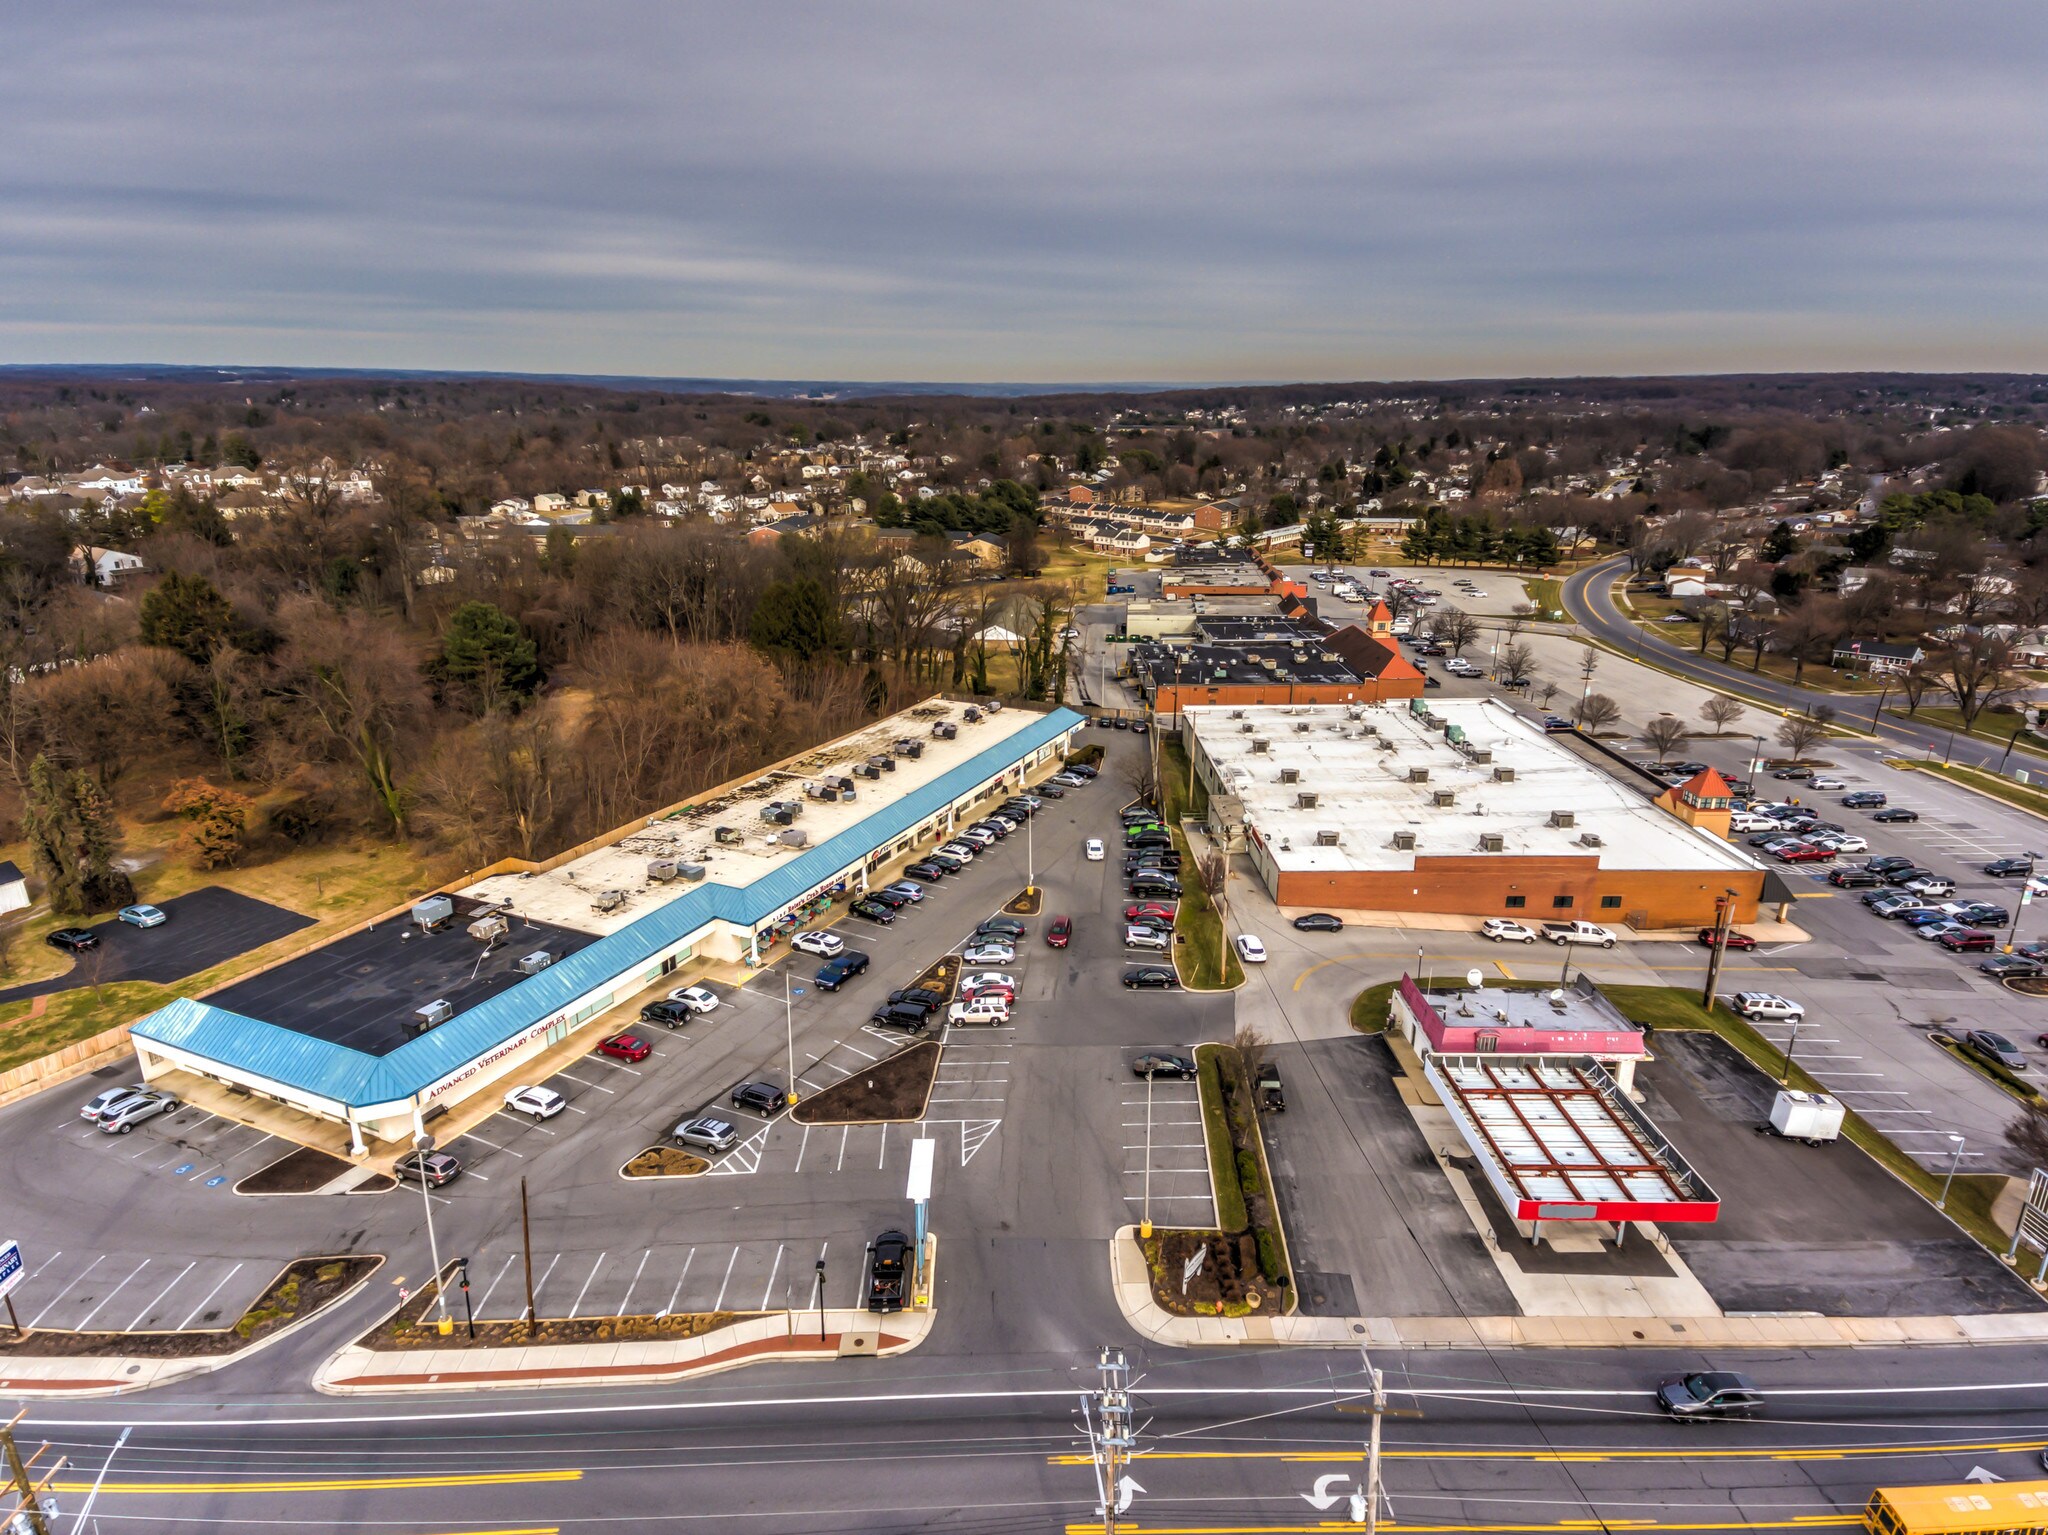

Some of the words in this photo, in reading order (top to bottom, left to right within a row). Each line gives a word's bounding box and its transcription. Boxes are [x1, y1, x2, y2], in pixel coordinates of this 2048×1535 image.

[429, 1068, 476, 1100] ADVANCED
[478, 1036, 527, 1069] VETERINARY
[530, 1013, 566, 1039] COMPLEX
